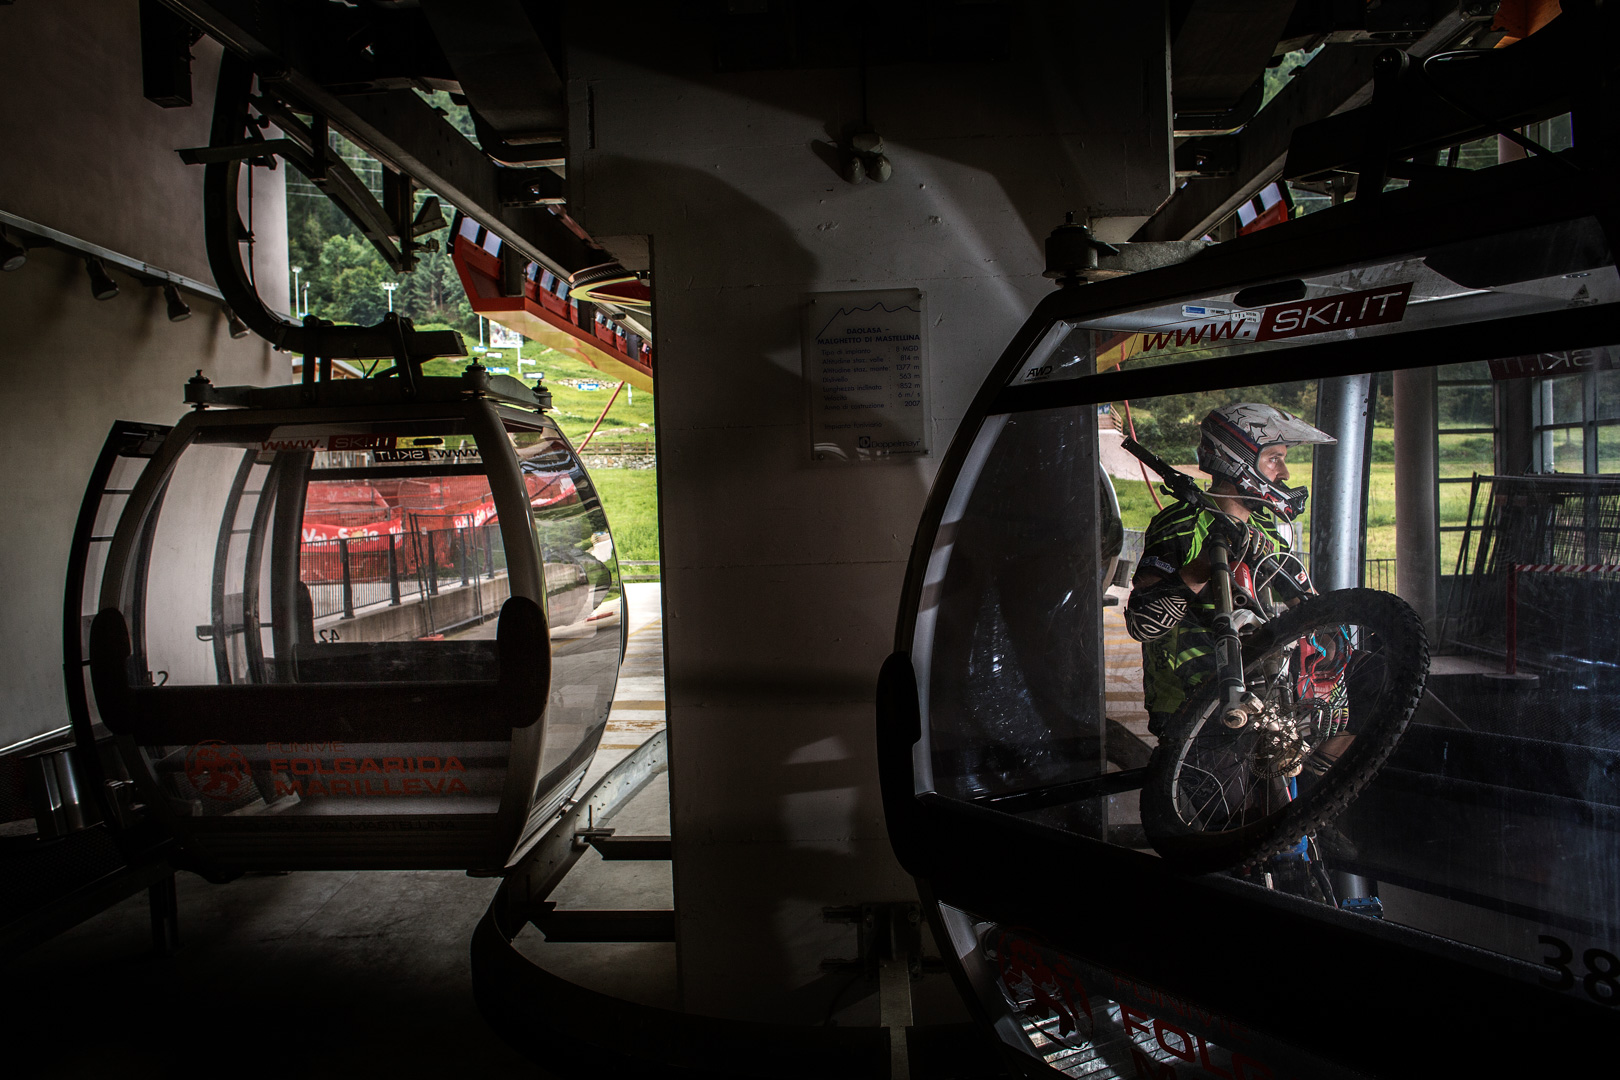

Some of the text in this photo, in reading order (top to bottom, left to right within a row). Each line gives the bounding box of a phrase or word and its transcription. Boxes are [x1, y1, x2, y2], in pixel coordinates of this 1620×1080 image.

[1142, 290, 1403, 352] www. SKI.IT
[818, 336, 862, 344] MALGHETTO
[876, 334, 920, 342] MASTELLINA
[334, 436, 393, 449] SKI.IT
[872, 440, 920, 448] Doppelmayr
[303, 528, 327, 546] Val
[266, 741, 345, 754] FUNIVIE
[270, 756, 466, 776] FOLGARIDA
[274, 778, 470, 797] MARILLEVA
[1537, 933, 1620, 1009] 38
